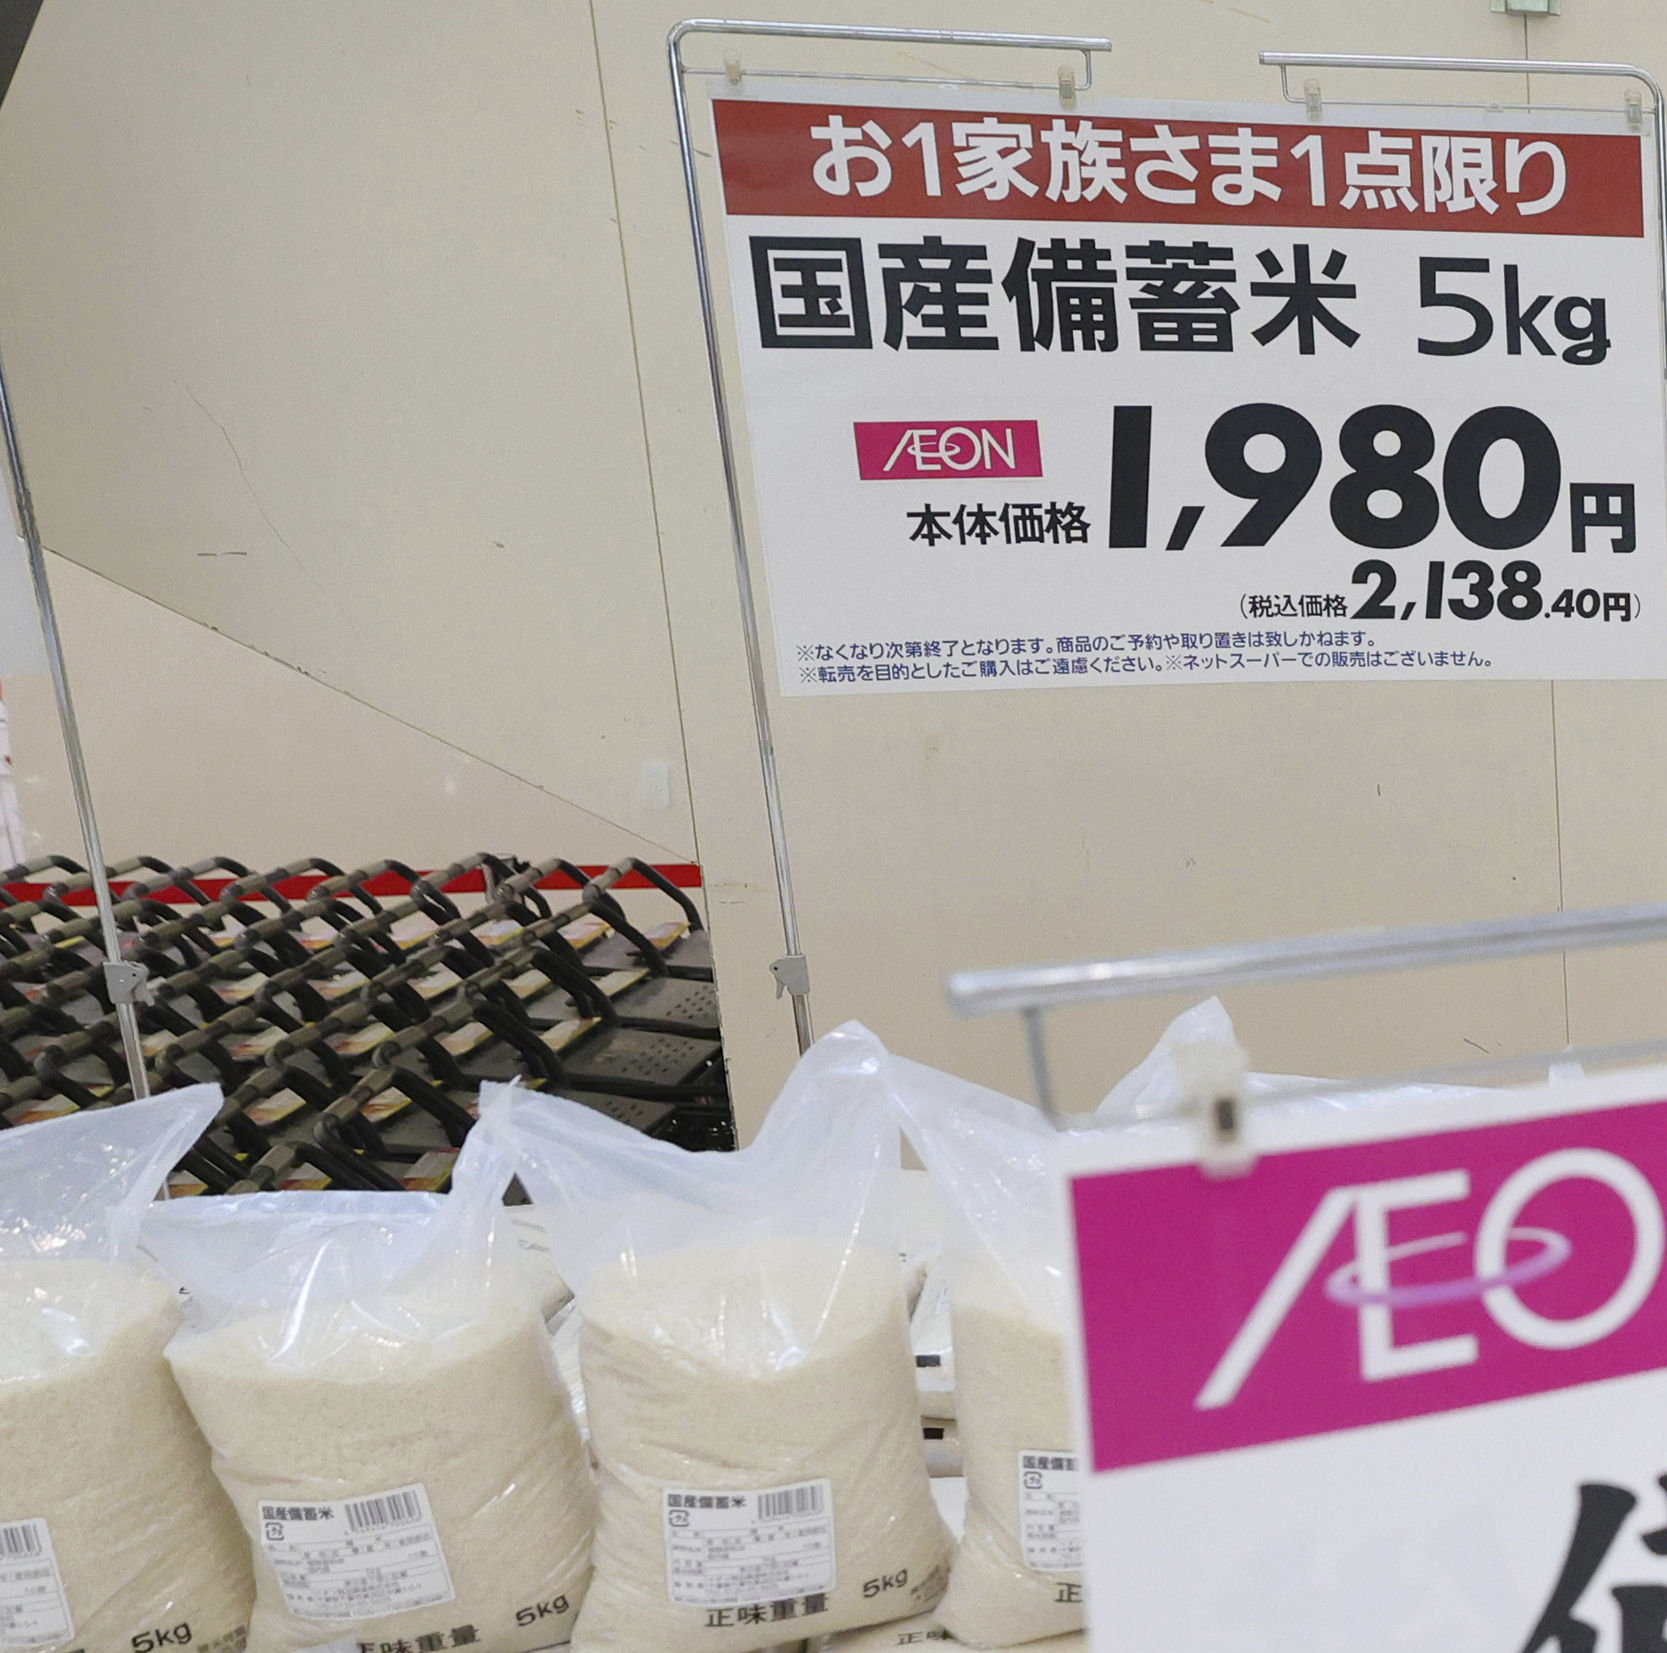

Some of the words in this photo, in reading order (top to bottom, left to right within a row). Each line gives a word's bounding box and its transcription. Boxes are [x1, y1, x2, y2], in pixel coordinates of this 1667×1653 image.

[809, 115, 1570, 216] お1家族さま1点限り
[748, 234, 1361, 356] 国産備蓄米
[1416, 256, 1611, 365] 5kg
[907, 501, 1091, 548] 本体価格
[515, 1593, 571, 1629] 5kg
[704, 1592, 829, 1628] 正味重量
[862, 1568, 909, 1599] 5kg
